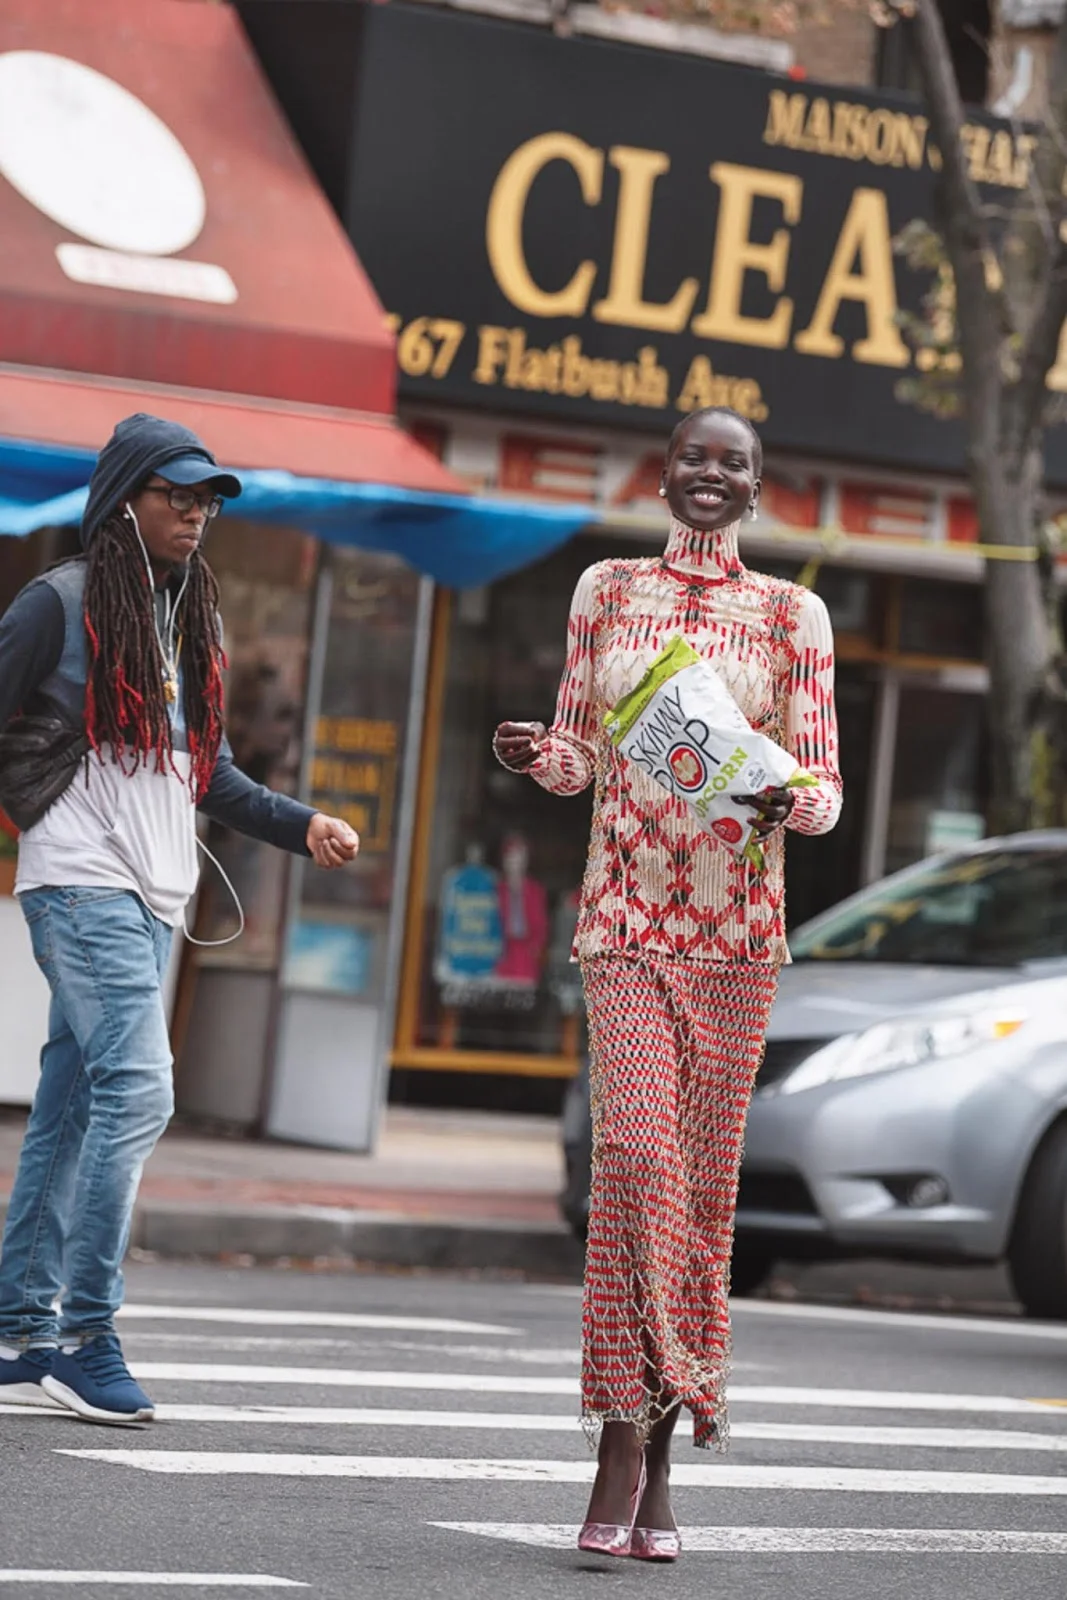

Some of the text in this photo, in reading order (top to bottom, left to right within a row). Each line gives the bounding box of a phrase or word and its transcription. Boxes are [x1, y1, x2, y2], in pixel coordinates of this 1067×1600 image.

[763, 89, 929, 171] MAISON
[385, 313, 466, 380] 67
[471, 324, 669, 410] Flatbush
[628, 685, 686, 775] SKINNY
